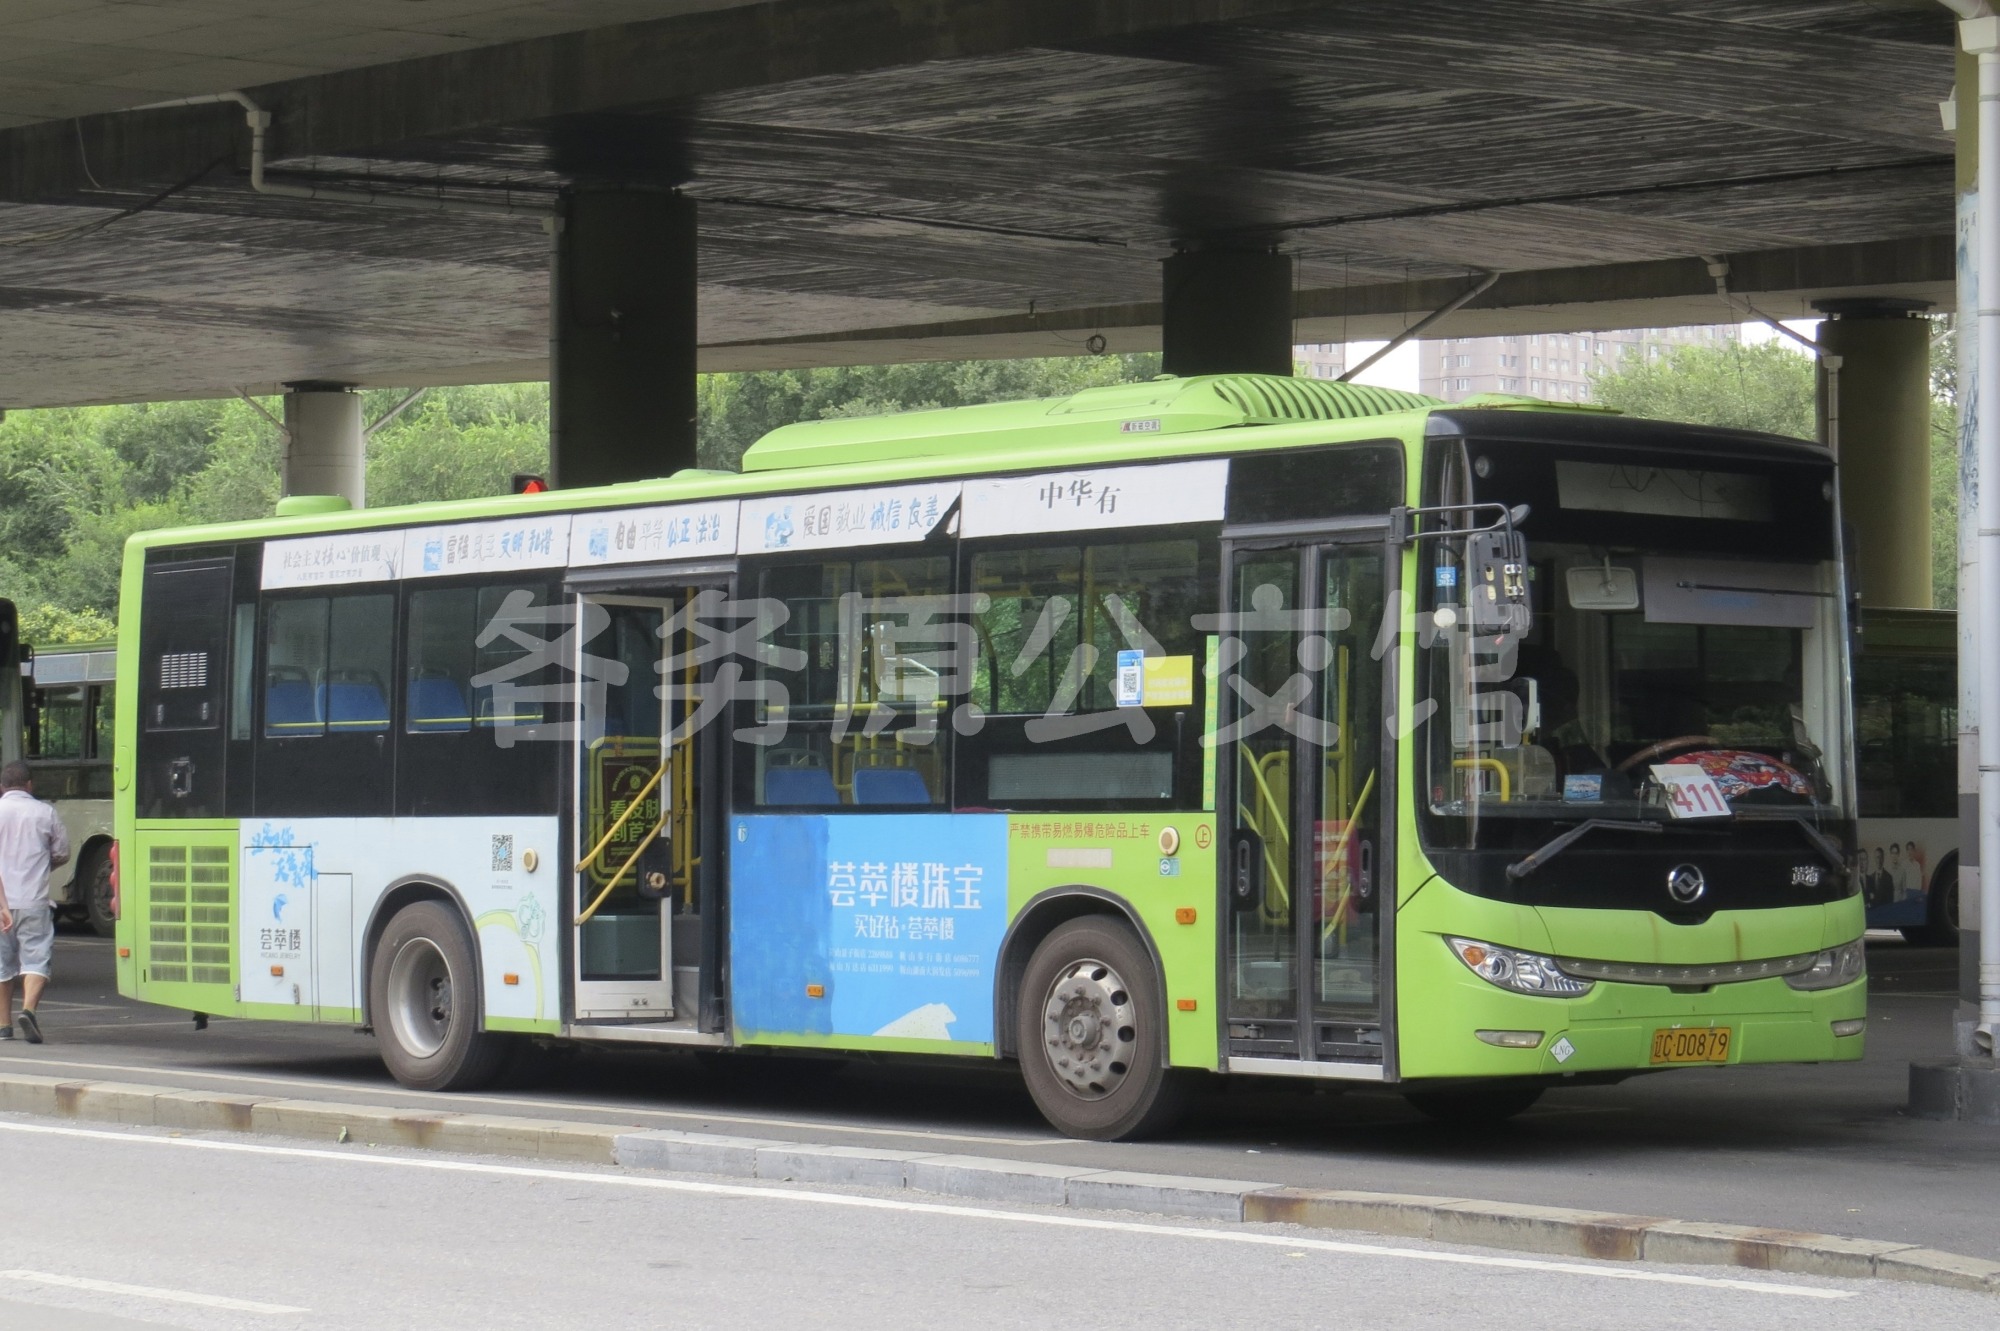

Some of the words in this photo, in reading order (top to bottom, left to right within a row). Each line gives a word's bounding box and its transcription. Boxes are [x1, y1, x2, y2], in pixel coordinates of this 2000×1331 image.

[1040, 480, 1121, 514] 中华有
[1674, 783, 1724, 812] 411
[1009, 823, 1150, 839] 严禁携带易燃易爆危险品上车
[829, 861, 983, 909] 荟萃楼珠宝
[261, 928, 301, 950] 荟萃楼
[1554, 1044, 1571, 1056] LNG
